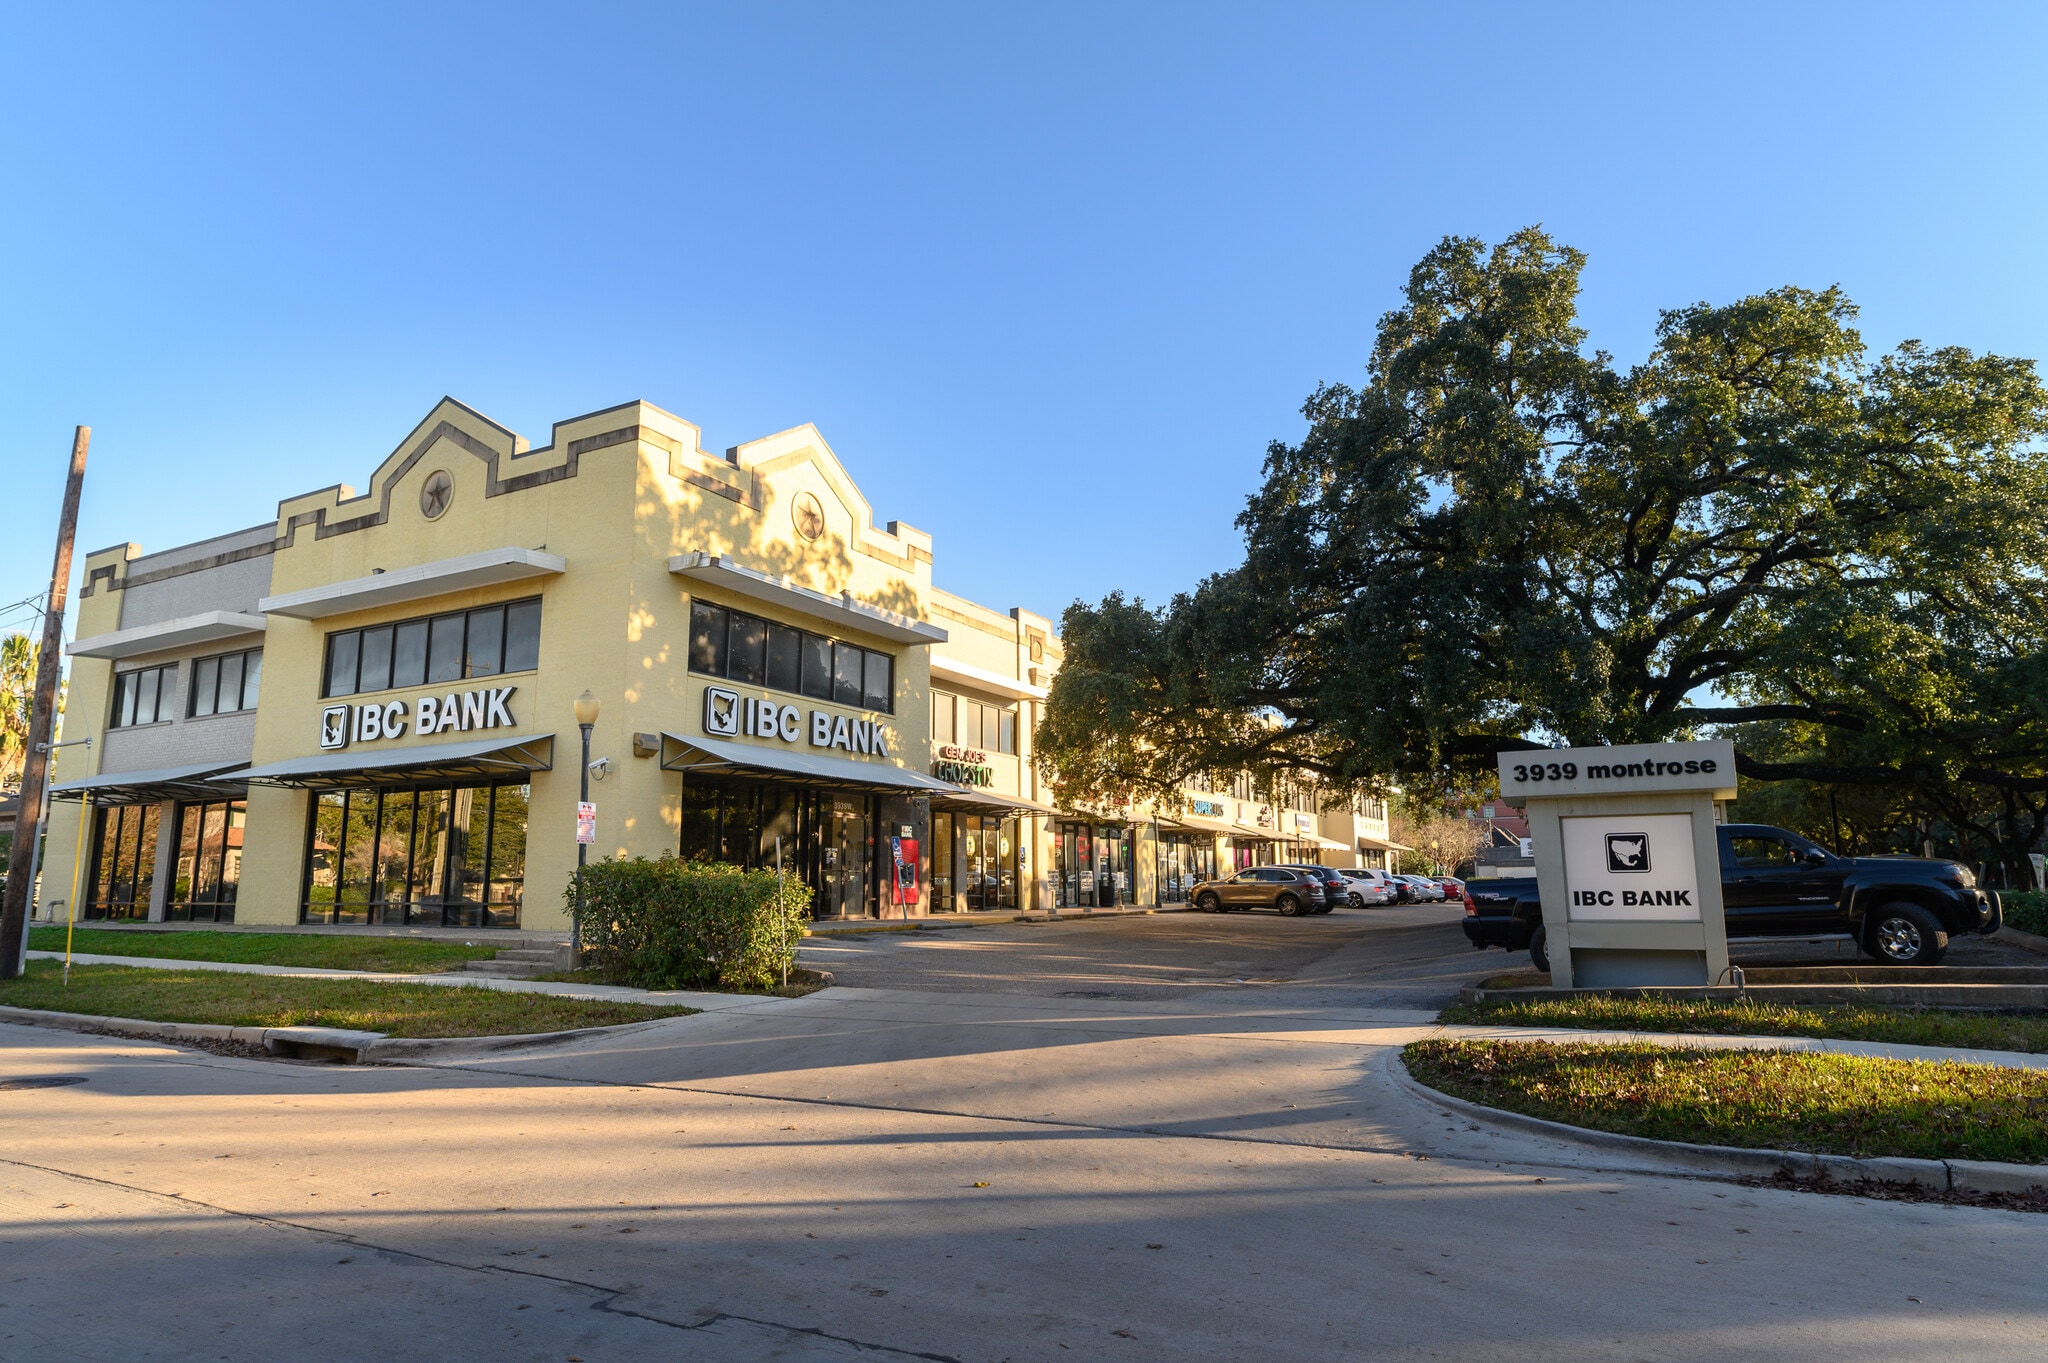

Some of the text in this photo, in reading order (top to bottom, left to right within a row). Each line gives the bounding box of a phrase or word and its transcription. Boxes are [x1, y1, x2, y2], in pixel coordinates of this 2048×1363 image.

[352, 686, 517, 742] IBC BANK
[745, 697, 889, 757] IBC BANK
[1513, 758, 1717, 783] 3939 montrose
[1573, 890, 1692, 906] IBC BANK
